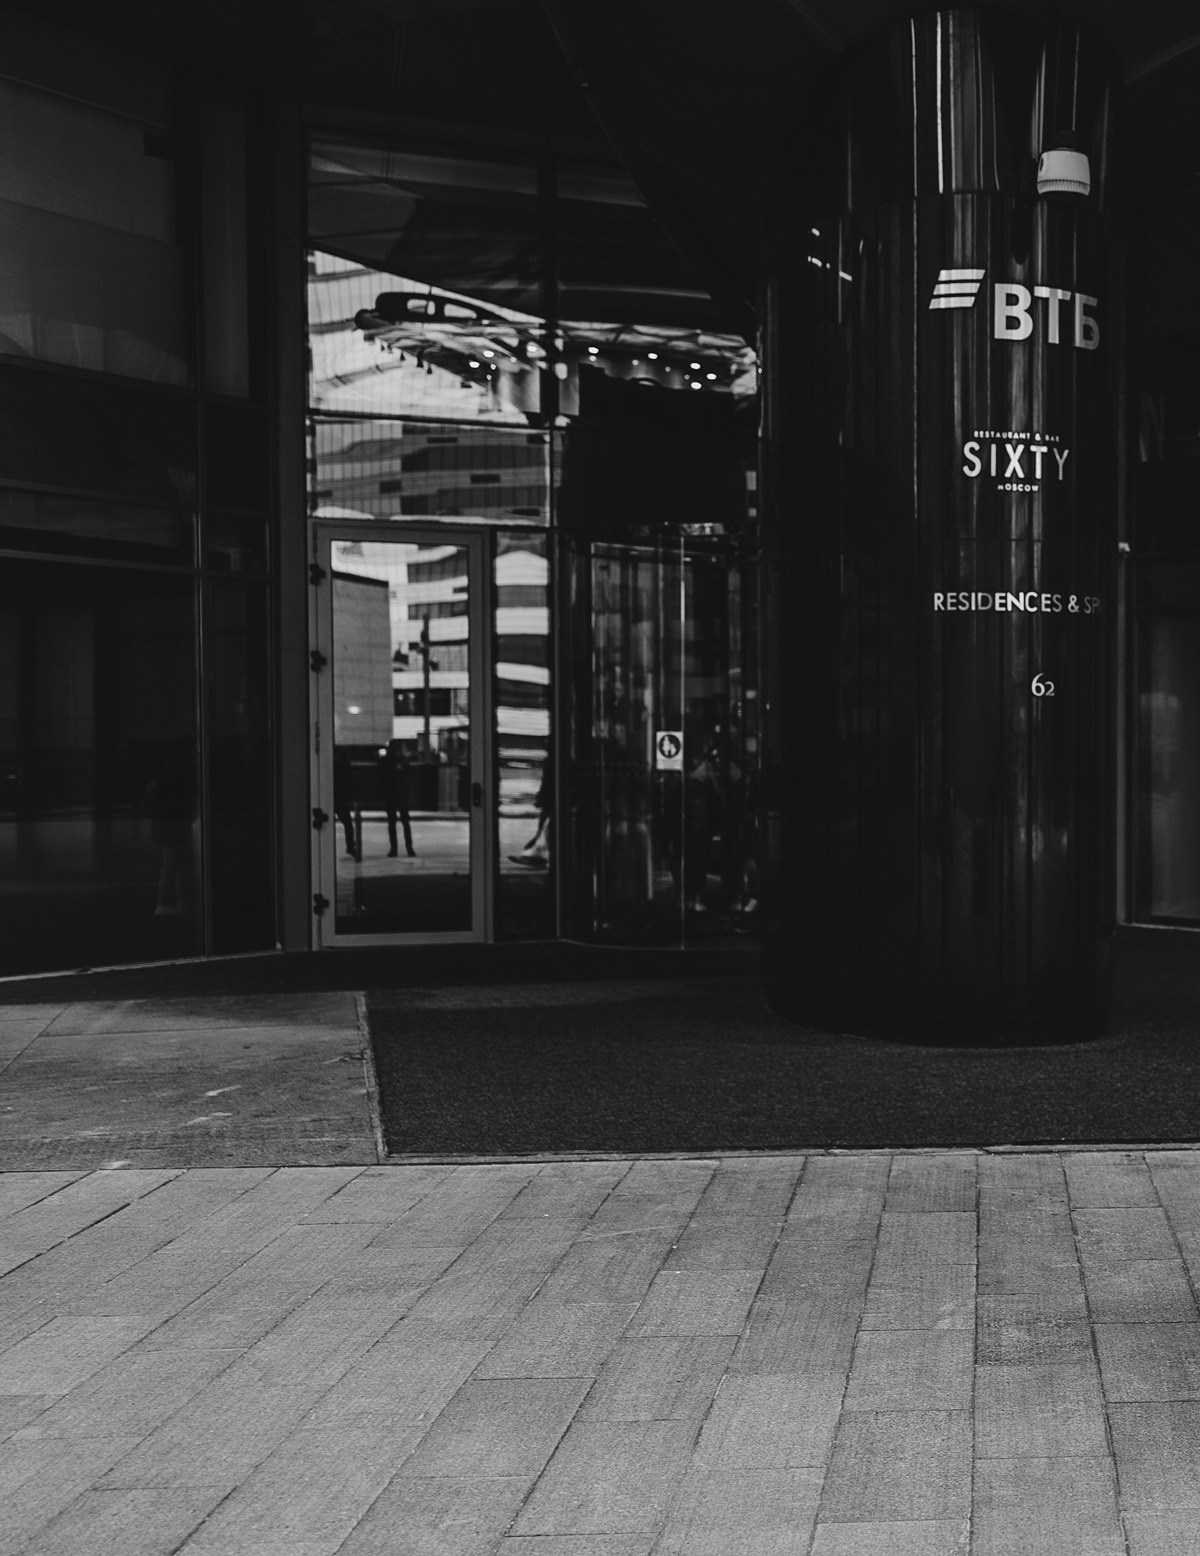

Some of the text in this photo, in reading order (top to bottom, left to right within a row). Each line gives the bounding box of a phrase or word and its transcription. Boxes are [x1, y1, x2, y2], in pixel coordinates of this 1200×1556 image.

[994, 283, 1099, 350] ВТБ
[974, 430, 1030, 440] RESTAURANT
[1034, 432, 1041, 441] &
[962, 441, 1069, 481] SIXTY
[997, 483, 1039, 492] MOSCOW
[933, 591, 1062, 613] RESIDENCES
[1067, 594, 1080, 613] &
[1031, 672, 1055, 697] 62
